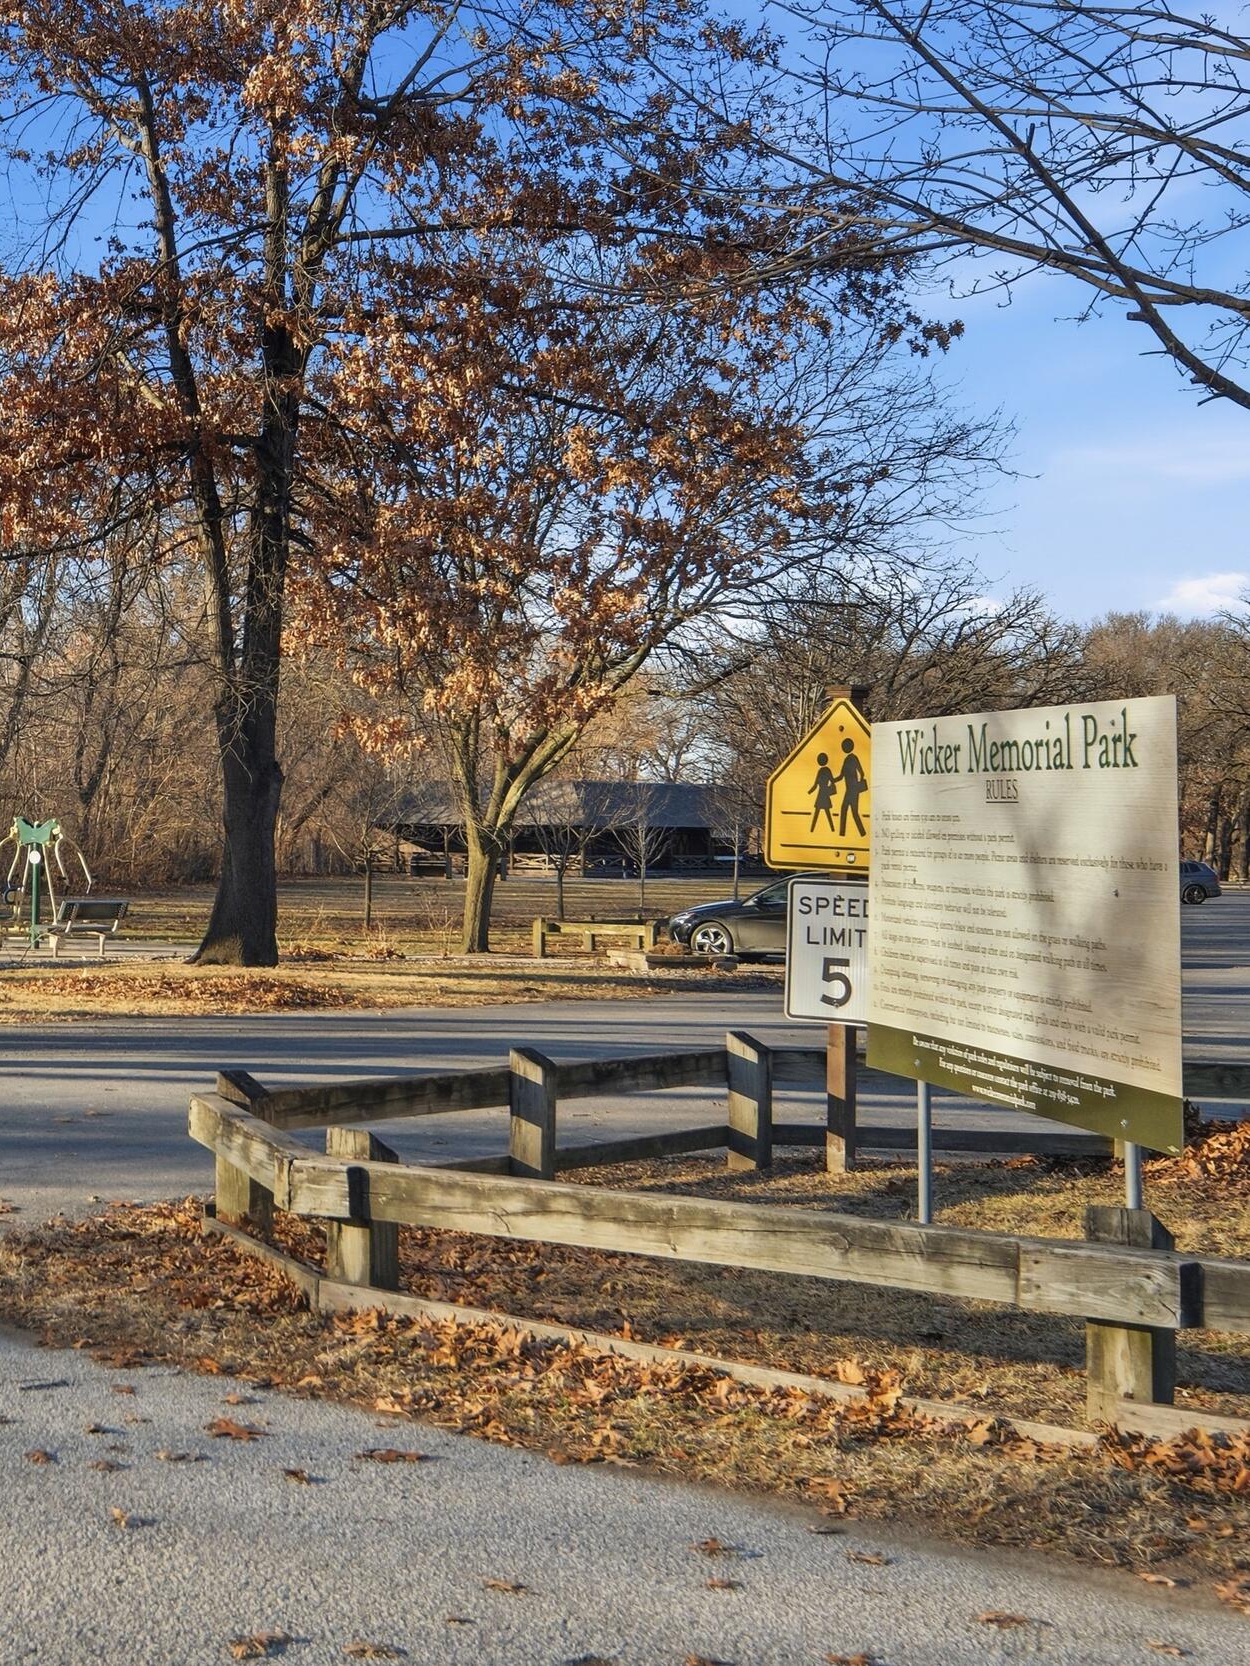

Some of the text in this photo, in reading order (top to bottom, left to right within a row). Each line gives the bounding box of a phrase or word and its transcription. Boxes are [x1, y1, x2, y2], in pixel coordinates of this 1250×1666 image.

[896, 707, 1139, 776] Wicker Memorial Park
[985, 779, 1019, 800] RULES
[806, 926, 867, 948] LIMIT
[820, 957, 852, 1009] 5
